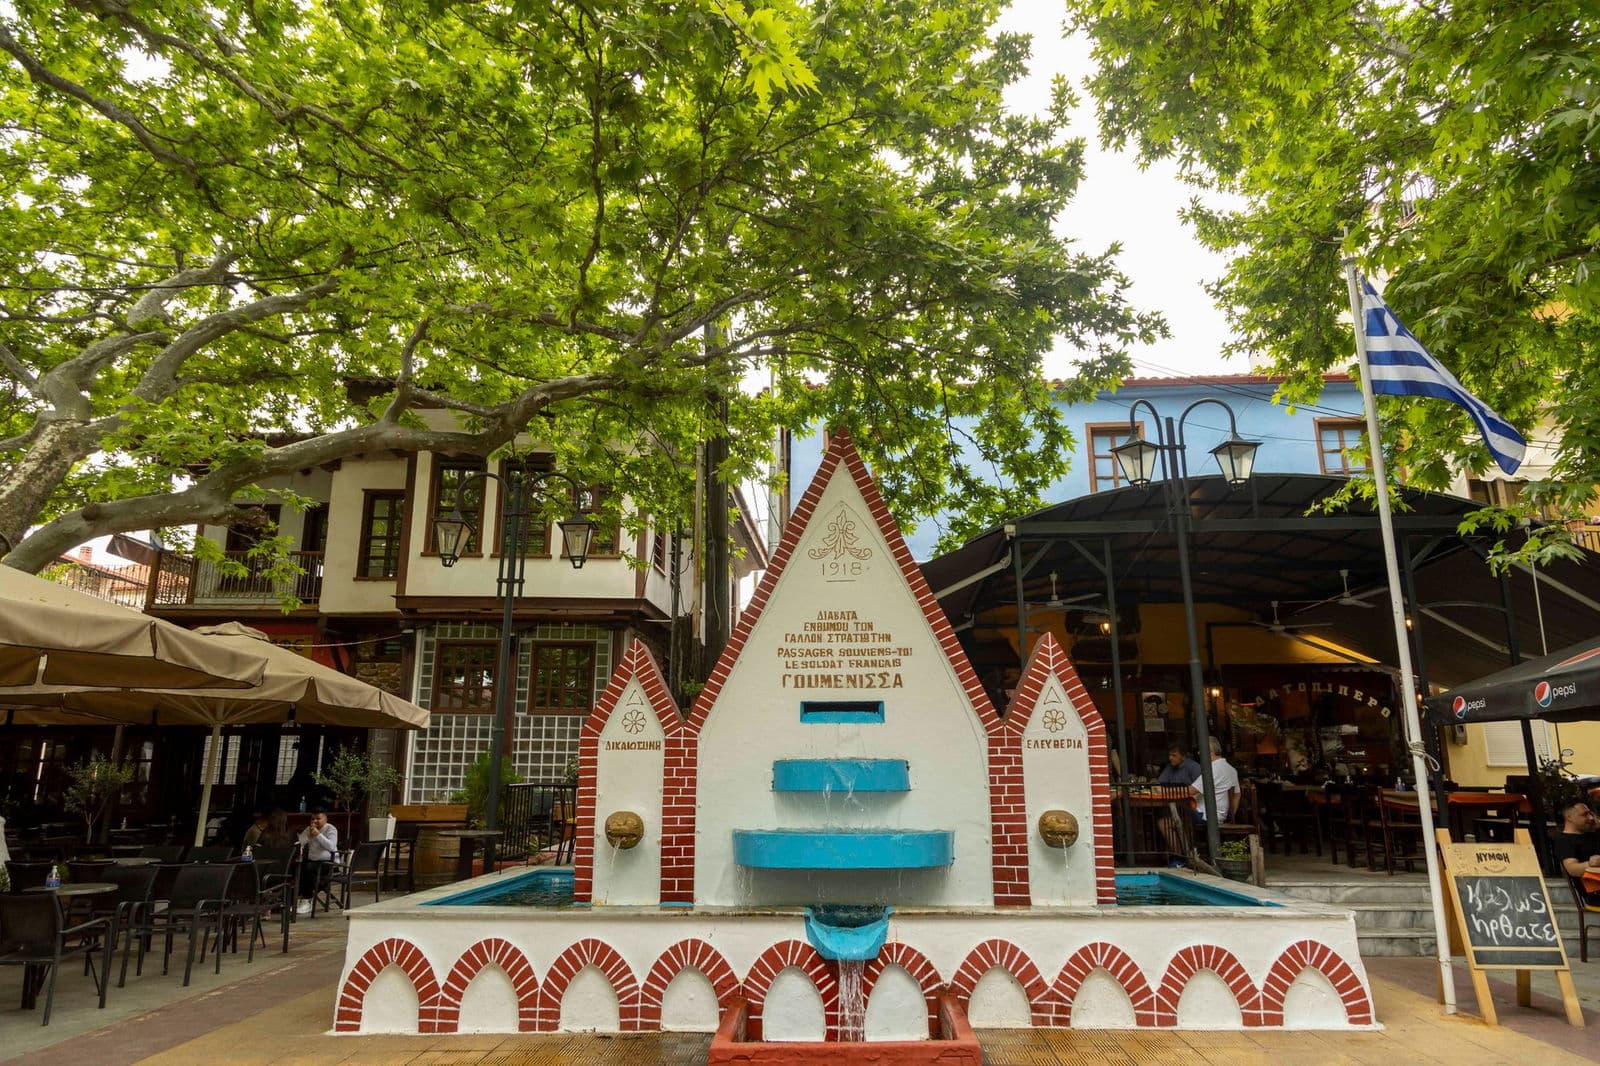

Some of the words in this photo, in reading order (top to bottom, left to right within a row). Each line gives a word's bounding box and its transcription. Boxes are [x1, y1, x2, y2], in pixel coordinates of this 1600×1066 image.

[821, 561, 863, 576] 1918
[777, 647, 834, 658] PASSAGER
[785, 660, 799, 670] LE
[800, 660, 844, 670] SOLDAT
[1552, 682, 1577, 699] pepsi
[1467, 697, 1487, 712] pepsi
